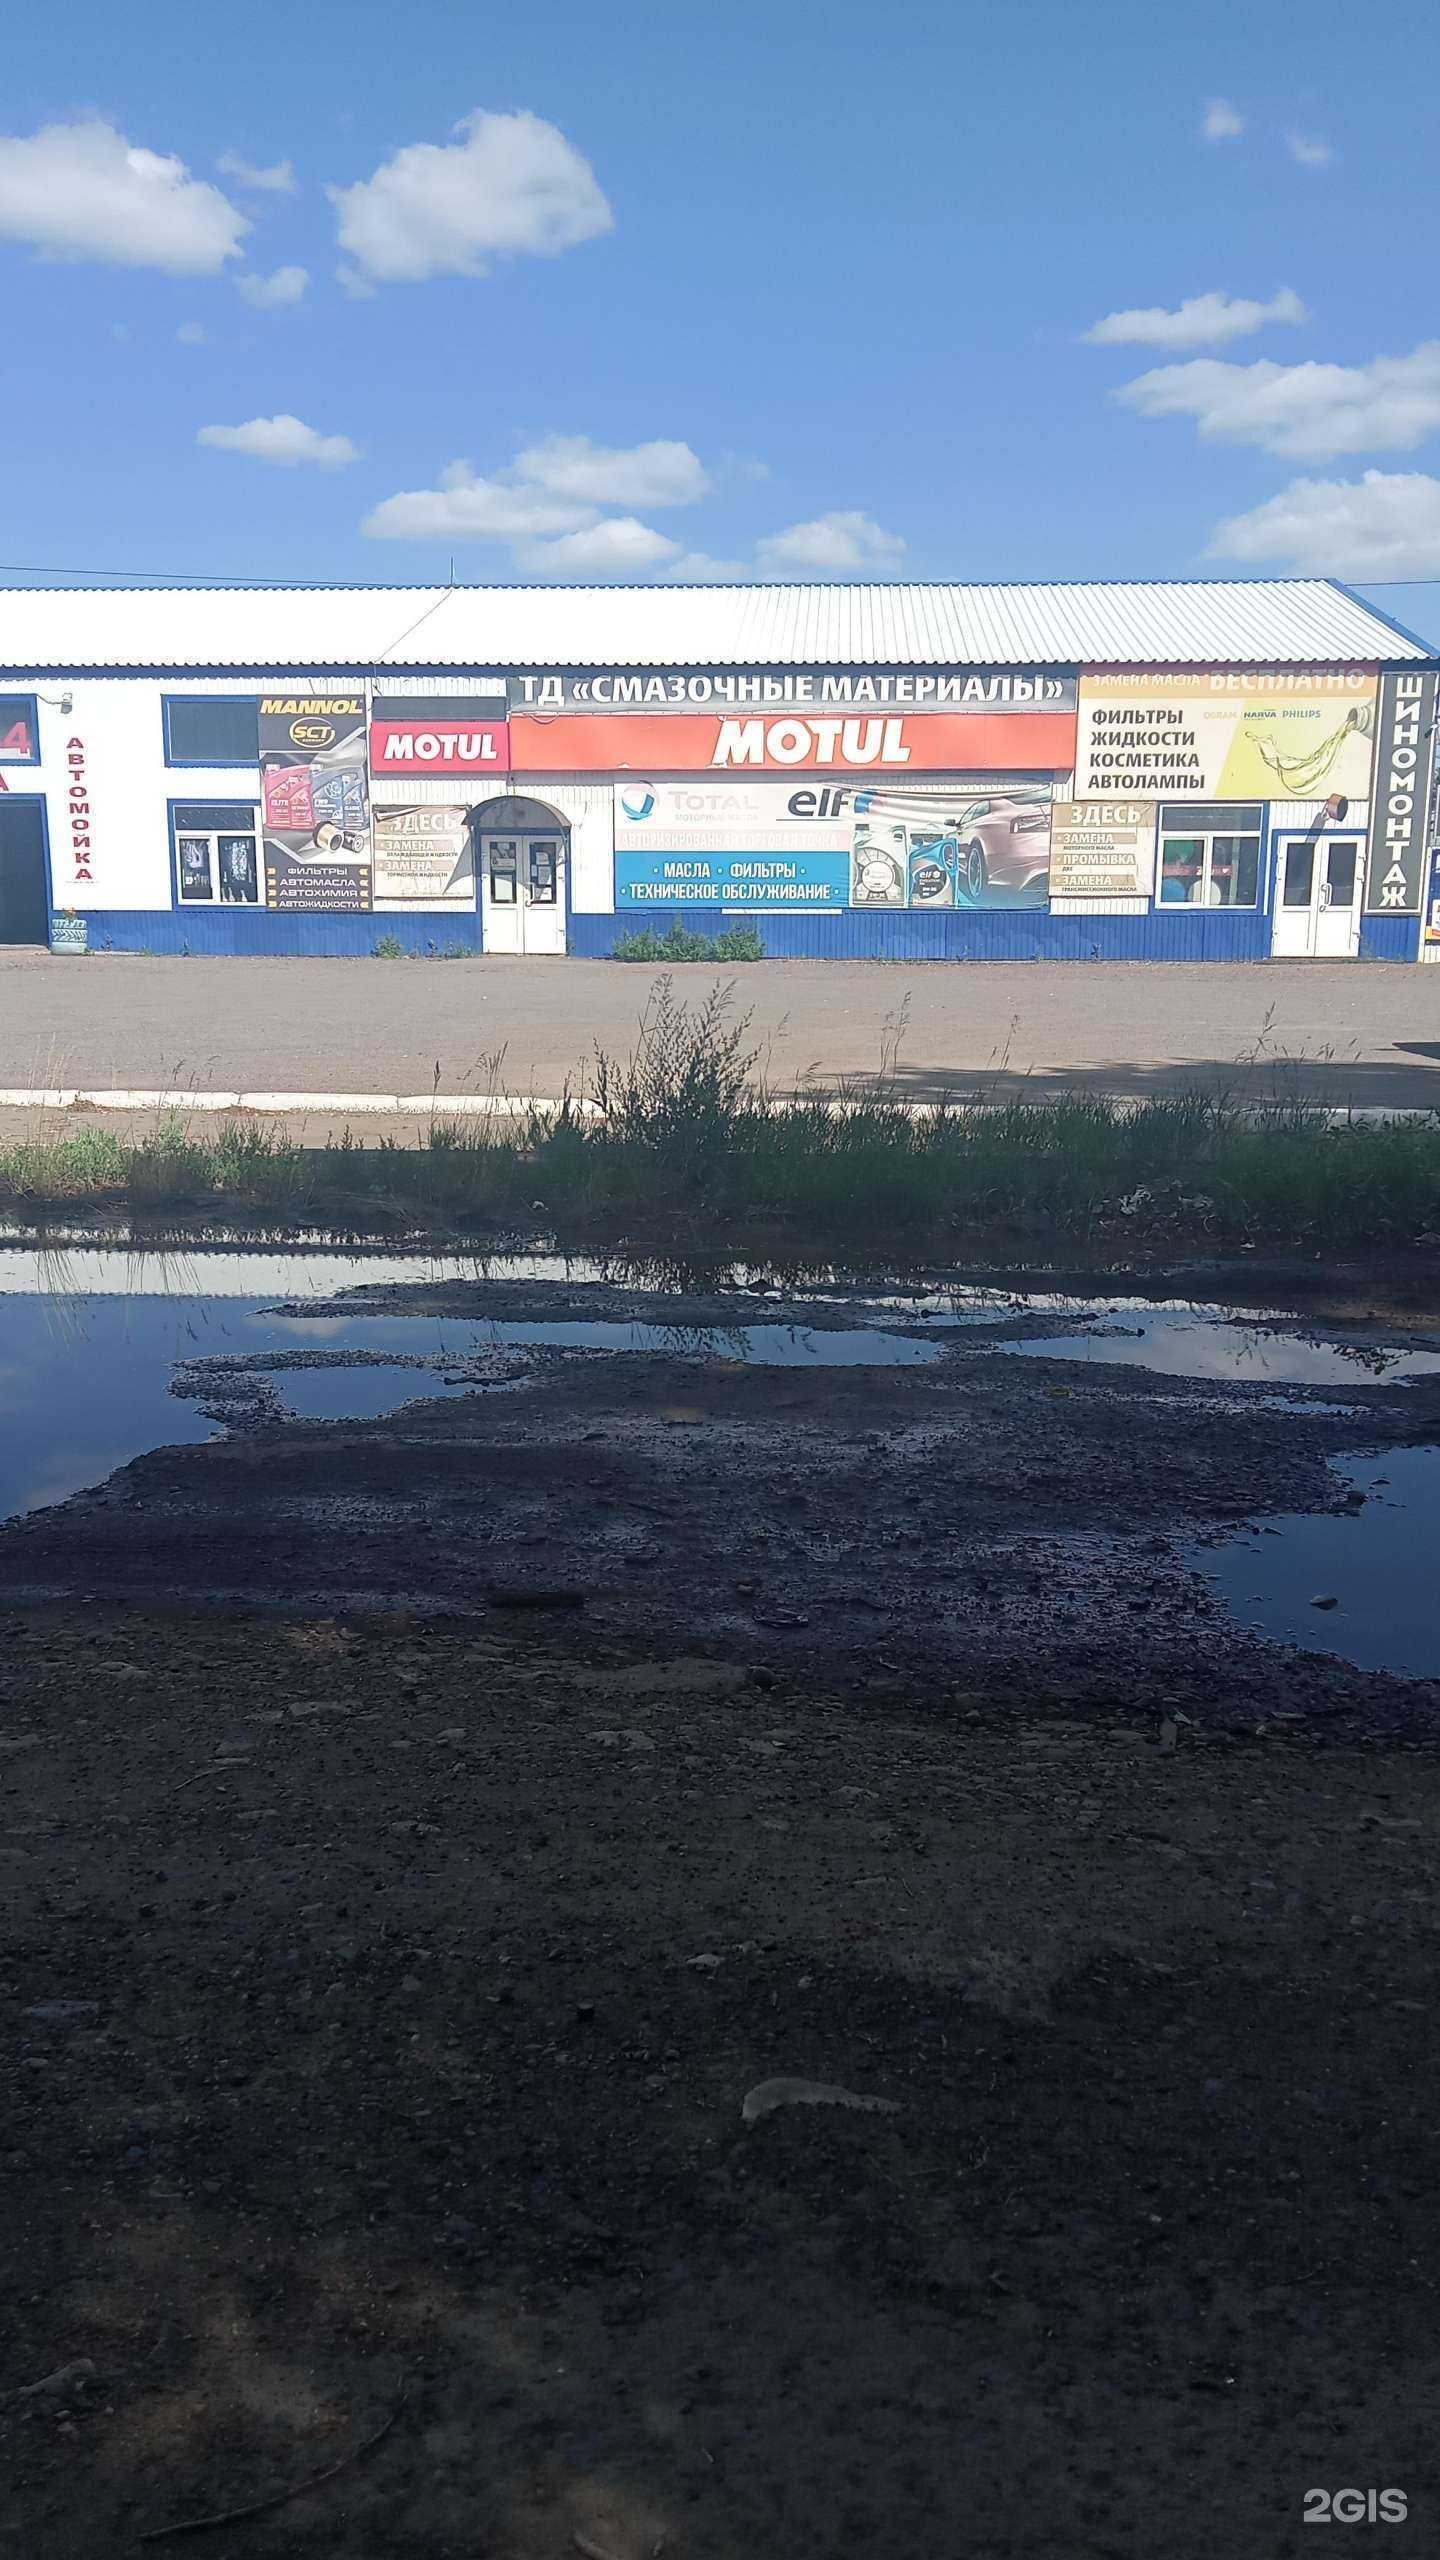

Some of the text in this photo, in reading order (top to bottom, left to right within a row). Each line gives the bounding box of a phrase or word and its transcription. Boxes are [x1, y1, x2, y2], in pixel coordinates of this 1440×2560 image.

[518, 675, 1064, 707] ТД «СМАЗОЧНЫЕ МАТЕРИАЛЫ»
[260, 699, 363, 715] MANNOL
[1282, 709, 1321, 719] PHILIPS
[1091, 709, 1183, 725] ФИЛЬТРЫ
[293, 726, 332, 739] SCT
[1090, 731, 1196, 748] ЖИДКОСТИ
[383, 733, 497, 761] MOTUL
[713, 718, 911, 765] MOTUL
[1089, 752, 1200, 769] КОСМЕТИКА
[1088, 774, 1205, 790] АВТОЛАМПЫ
[1380, 676, 1423, 907] ШИНОМОНТАЖ
[66, 736, 93, 880] АВТОМОЙКА
[787, 788, 849, 817] elf
[1071, 806, 1140, 826] ЗДЕСЬ
[384, 840, 434, 850] ЗАМЕНА
[1064, 834, 1114, 844] ЗАМЕНА
[384, 861, 432, 871] ЗАМЕНА
[1063, 854, 1135, 864] ПРОМЫВКА
[664, 862, 795, 878] МАСЛА ФИЛЬТРЫ
[280, 879, 356, 887] АВТОМАСЛА
[1062, 876, 1112, 886] ЗАМЕНА
[280, 889, 357, 897] АВТОХИМИЯ
[629, 883, 830, 899] ТЕХНИЧЕСКОЕ ОБСЛУЖИВАНИЕ
[279, 900, 359, 908] АВТОЖИДКОСТИ
